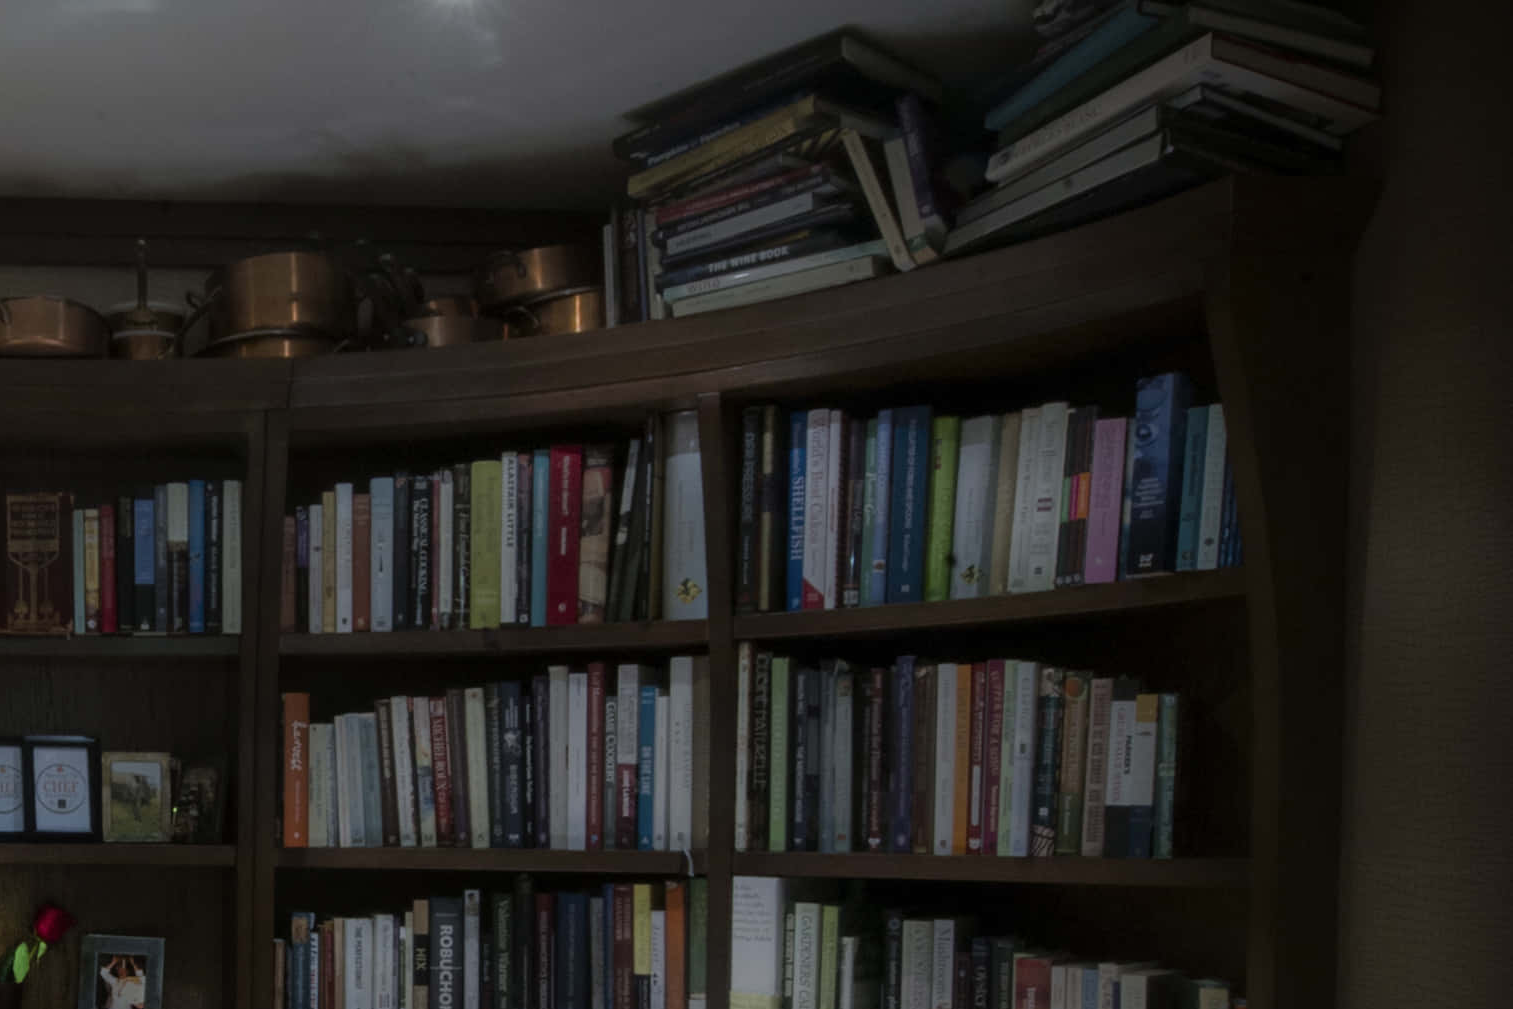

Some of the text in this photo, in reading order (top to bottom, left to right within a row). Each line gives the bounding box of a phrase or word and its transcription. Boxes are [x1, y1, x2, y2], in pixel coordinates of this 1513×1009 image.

[506, 513, 514, 548] LITTLE
[790, 475, 804, 561] SHELLFISH
[431, 717, 448, 791] MICHEL ROUX
[605, 701, 616, 784] GAME COOKERY
[1123, 734, 1133, 775] PARKER'S
[42, 780, 78, 793] CHEF
[935, 926, 952, 1001] Mushrooms
